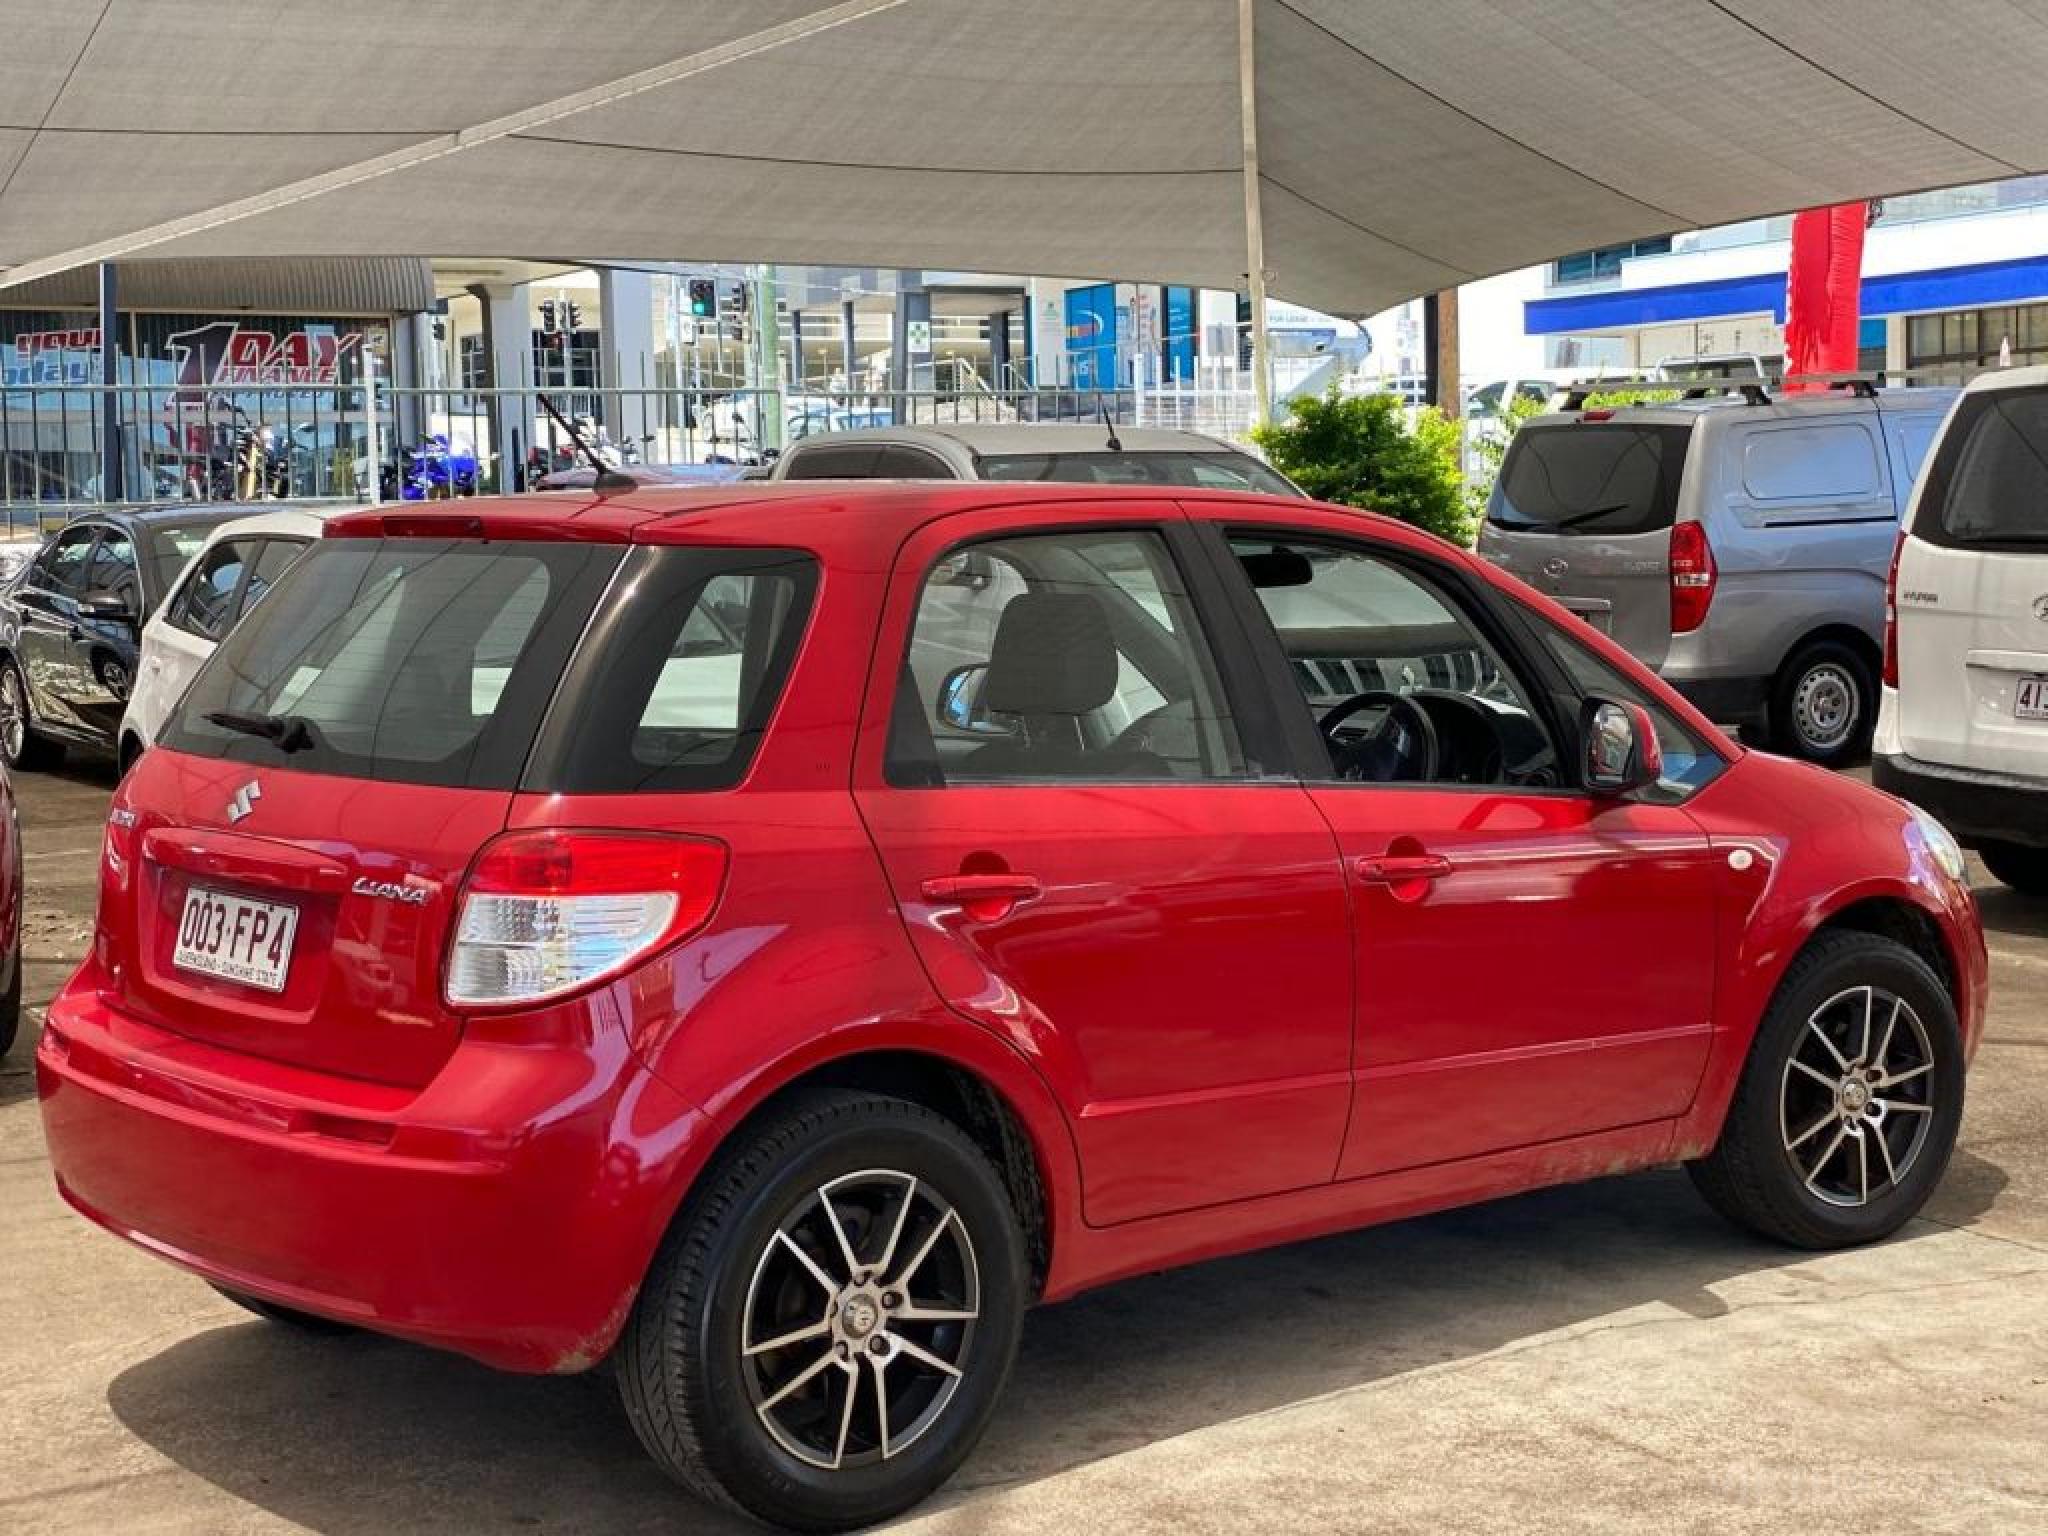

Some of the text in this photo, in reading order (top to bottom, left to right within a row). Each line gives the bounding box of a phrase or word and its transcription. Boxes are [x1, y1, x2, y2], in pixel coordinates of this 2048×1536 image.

[227, 331, 362, 367] DAY
[2019, 683, 2048, 709] 41
[352, 876, 427, 905] LIANA
